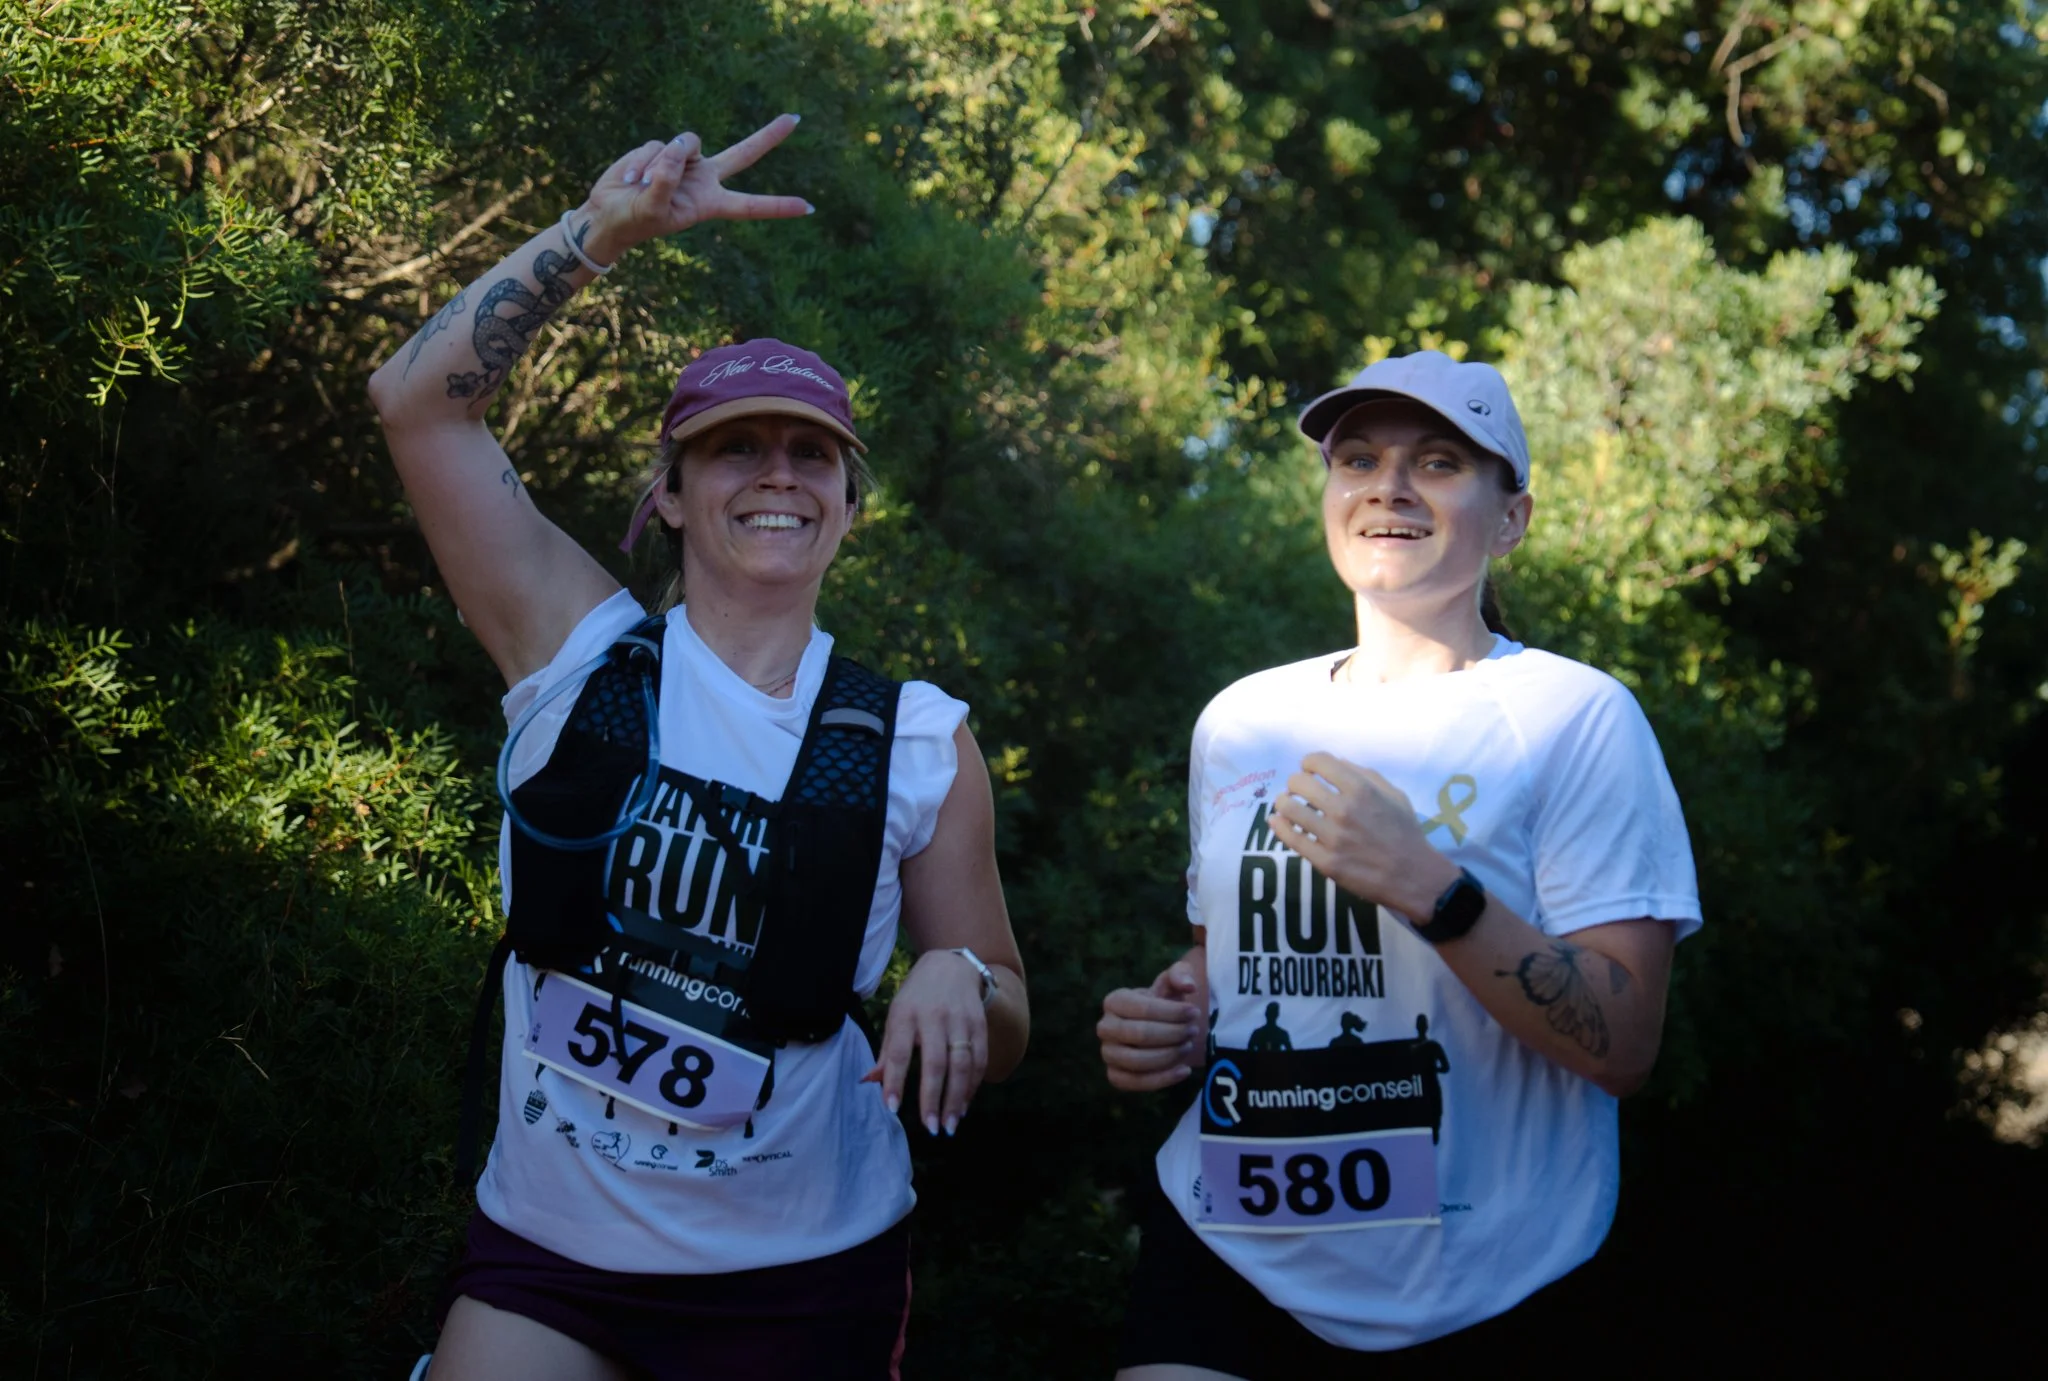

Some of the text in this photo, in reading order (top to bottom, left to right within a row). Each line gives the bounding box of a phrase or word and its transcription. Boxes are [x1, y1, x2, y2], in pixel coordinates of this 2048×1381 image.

[700, 355, 835, 391] New Balance
[609, 824, 770, 948] RUN
[1238, 855, 1382, 955] RUN
[1238, 956, 1385, 998] DE BOURBAKI
[567, 1001, 714, 1109] 578
[1248, 1074, 1423, 1111] runningconseil
[708, 1164, 738, 1177] Smith
[715, 1159, 729, 1169] DS
[1238, 1148, 1391, 1217] 580
